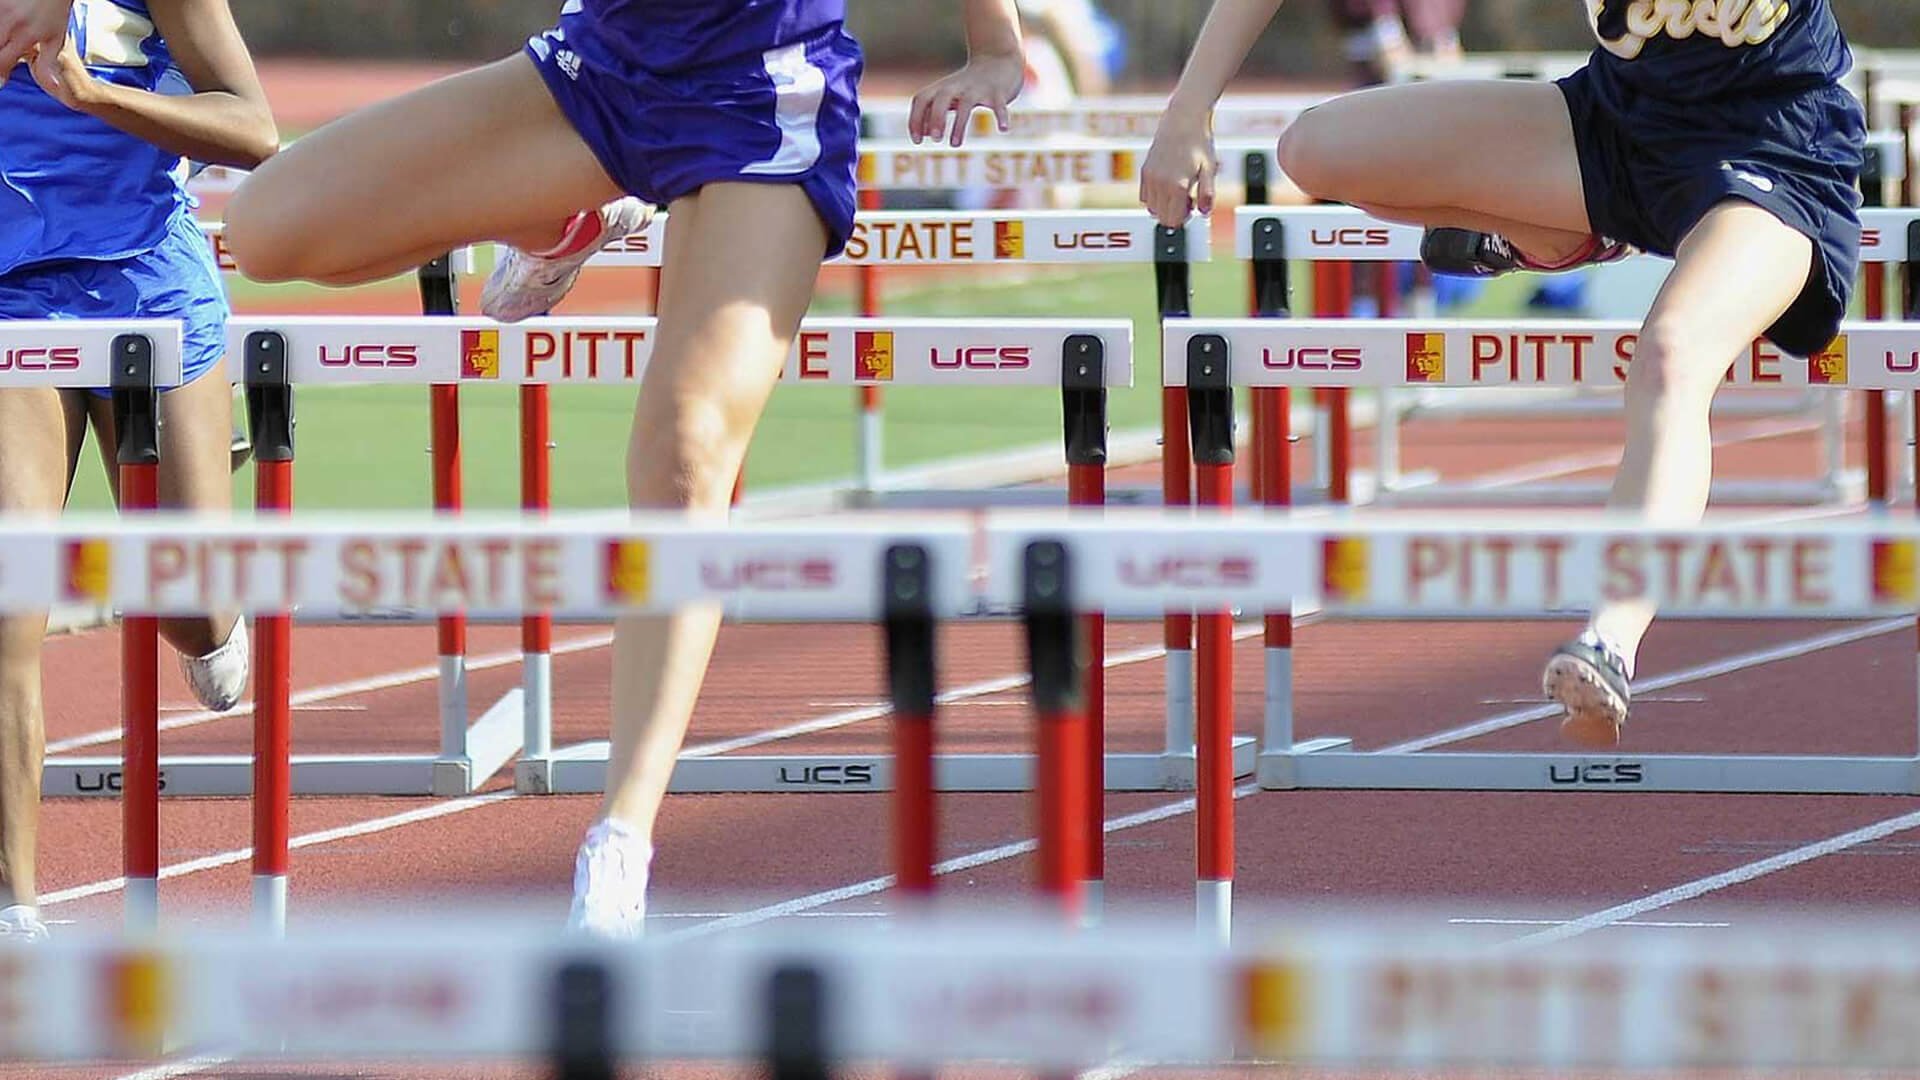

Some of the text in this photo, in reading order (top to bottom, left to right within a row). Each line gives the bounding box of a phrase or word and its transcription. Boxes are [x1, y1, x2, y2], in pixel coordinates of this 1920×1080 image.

[892, 152, 1091, 185] PITT STATE
[845, 221, 974, 260] STATE
[1053, 232, 1131, 249] UCS
[1311, 229, 1389, 245] UCS
[318, 344, 418, 367] UCS
[524, 331, 645, 380] PITT
[930, 346, 1030, 369] UCS
[1262, 347, 1362, 370] UCS
[1471, 334, 1594, 382] PITT
[147, 538, 563, 600] PITT STATE
[1405, 536, 1832, 599] PITT STATE
[780, 764, 874, 784] UCS
[1549, 763, 1642, 784] UCS
